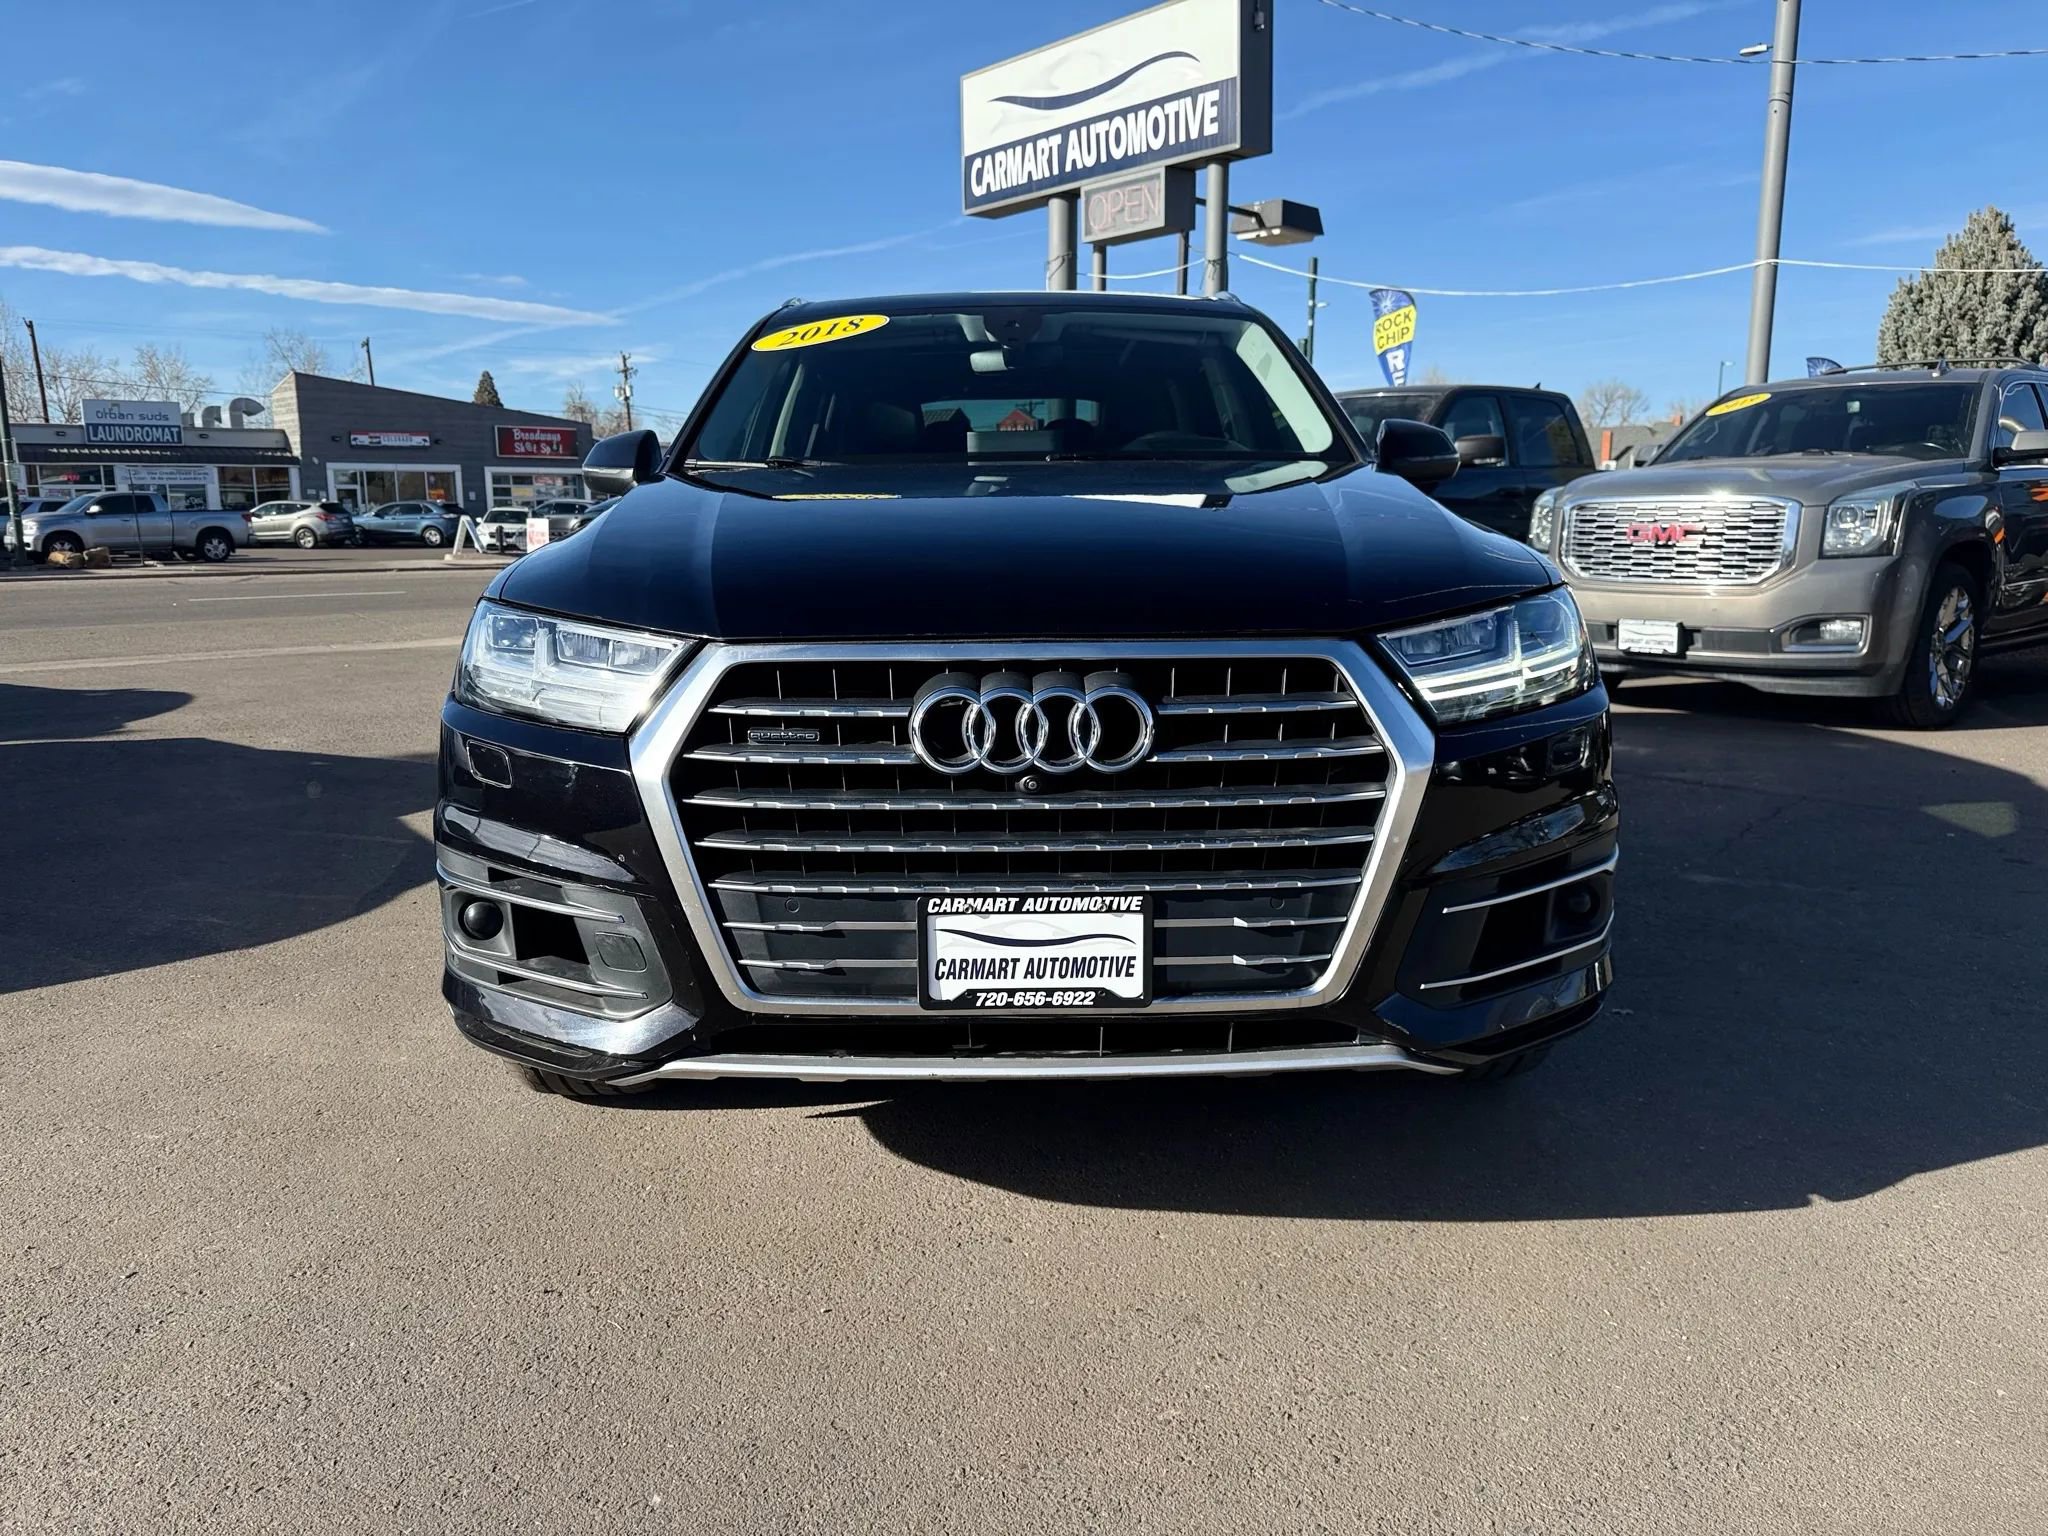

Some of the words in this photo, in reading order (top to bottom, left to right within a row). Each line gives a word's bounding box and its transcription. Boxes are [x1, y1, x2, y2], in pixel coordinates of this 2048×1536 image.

[970, 133, 1062, 197] CARMART
[1064, 89, 1220, 173] AUTOMOTIVE
[1088, 180, 1161, 231] OPEN
[776, 317, 865, 347] 2018
[1377, 326, 1411, 350] CHIP
[138, 411, 170, 421] suds
[88, 425, 180, 443] LAUNDROMAT
[1626, 522, 1704, 545] GMC
[750, 732, 816, 740] quattro
[927, 897, 1019, 913] CARMART
[1021, 896, 1143, 913] AUTOMOTIVE
[934, 957, 1020, 981] CARMART
[1023, 956, 1137, 980] AUTOMOTIVE
[975, 991, 1096, 1007] 720-656-6922
